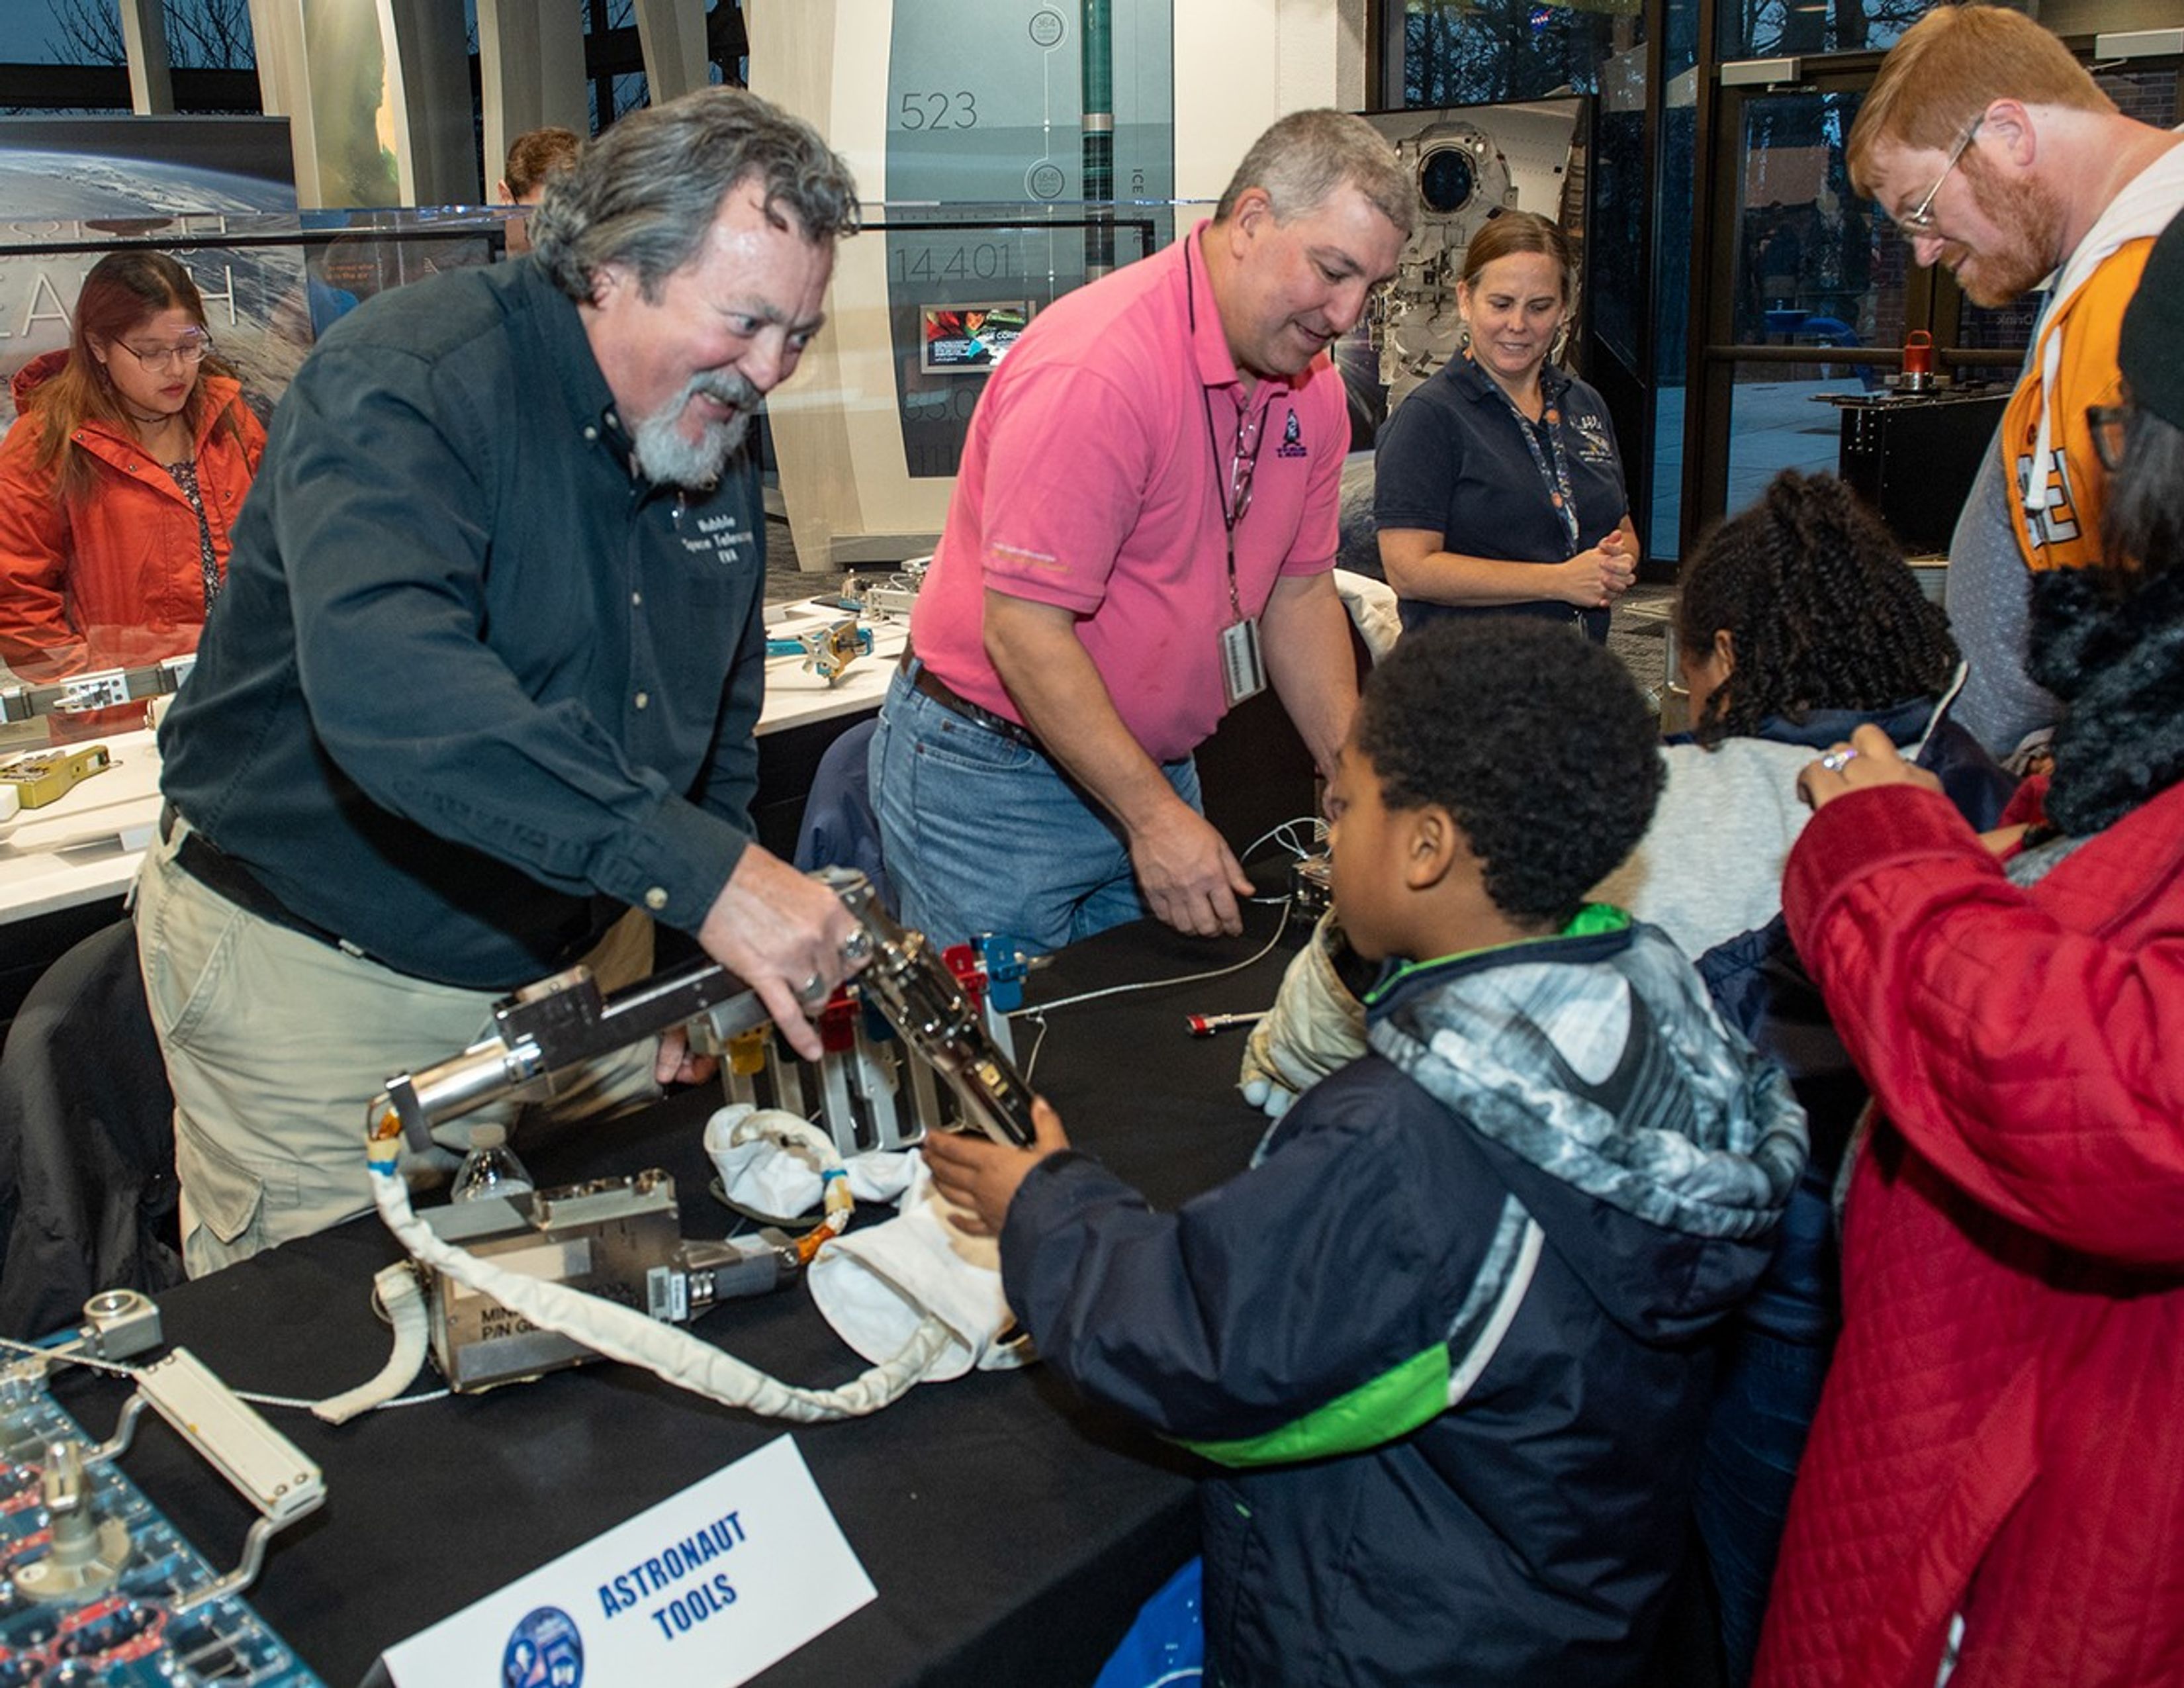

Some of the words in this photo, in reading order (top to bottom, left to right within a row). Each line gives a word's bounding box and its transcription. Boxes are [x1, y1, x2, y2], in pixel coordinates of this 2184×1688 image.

[901, 91, 978, 130] 523
[1132, 168, 1144, 194] ICE
[895, 243, 1011, 287] 14,401
[598, 1511, 746, 1618] ASTRONAUT
[651, 1573, 737, 1641] TOOLS
